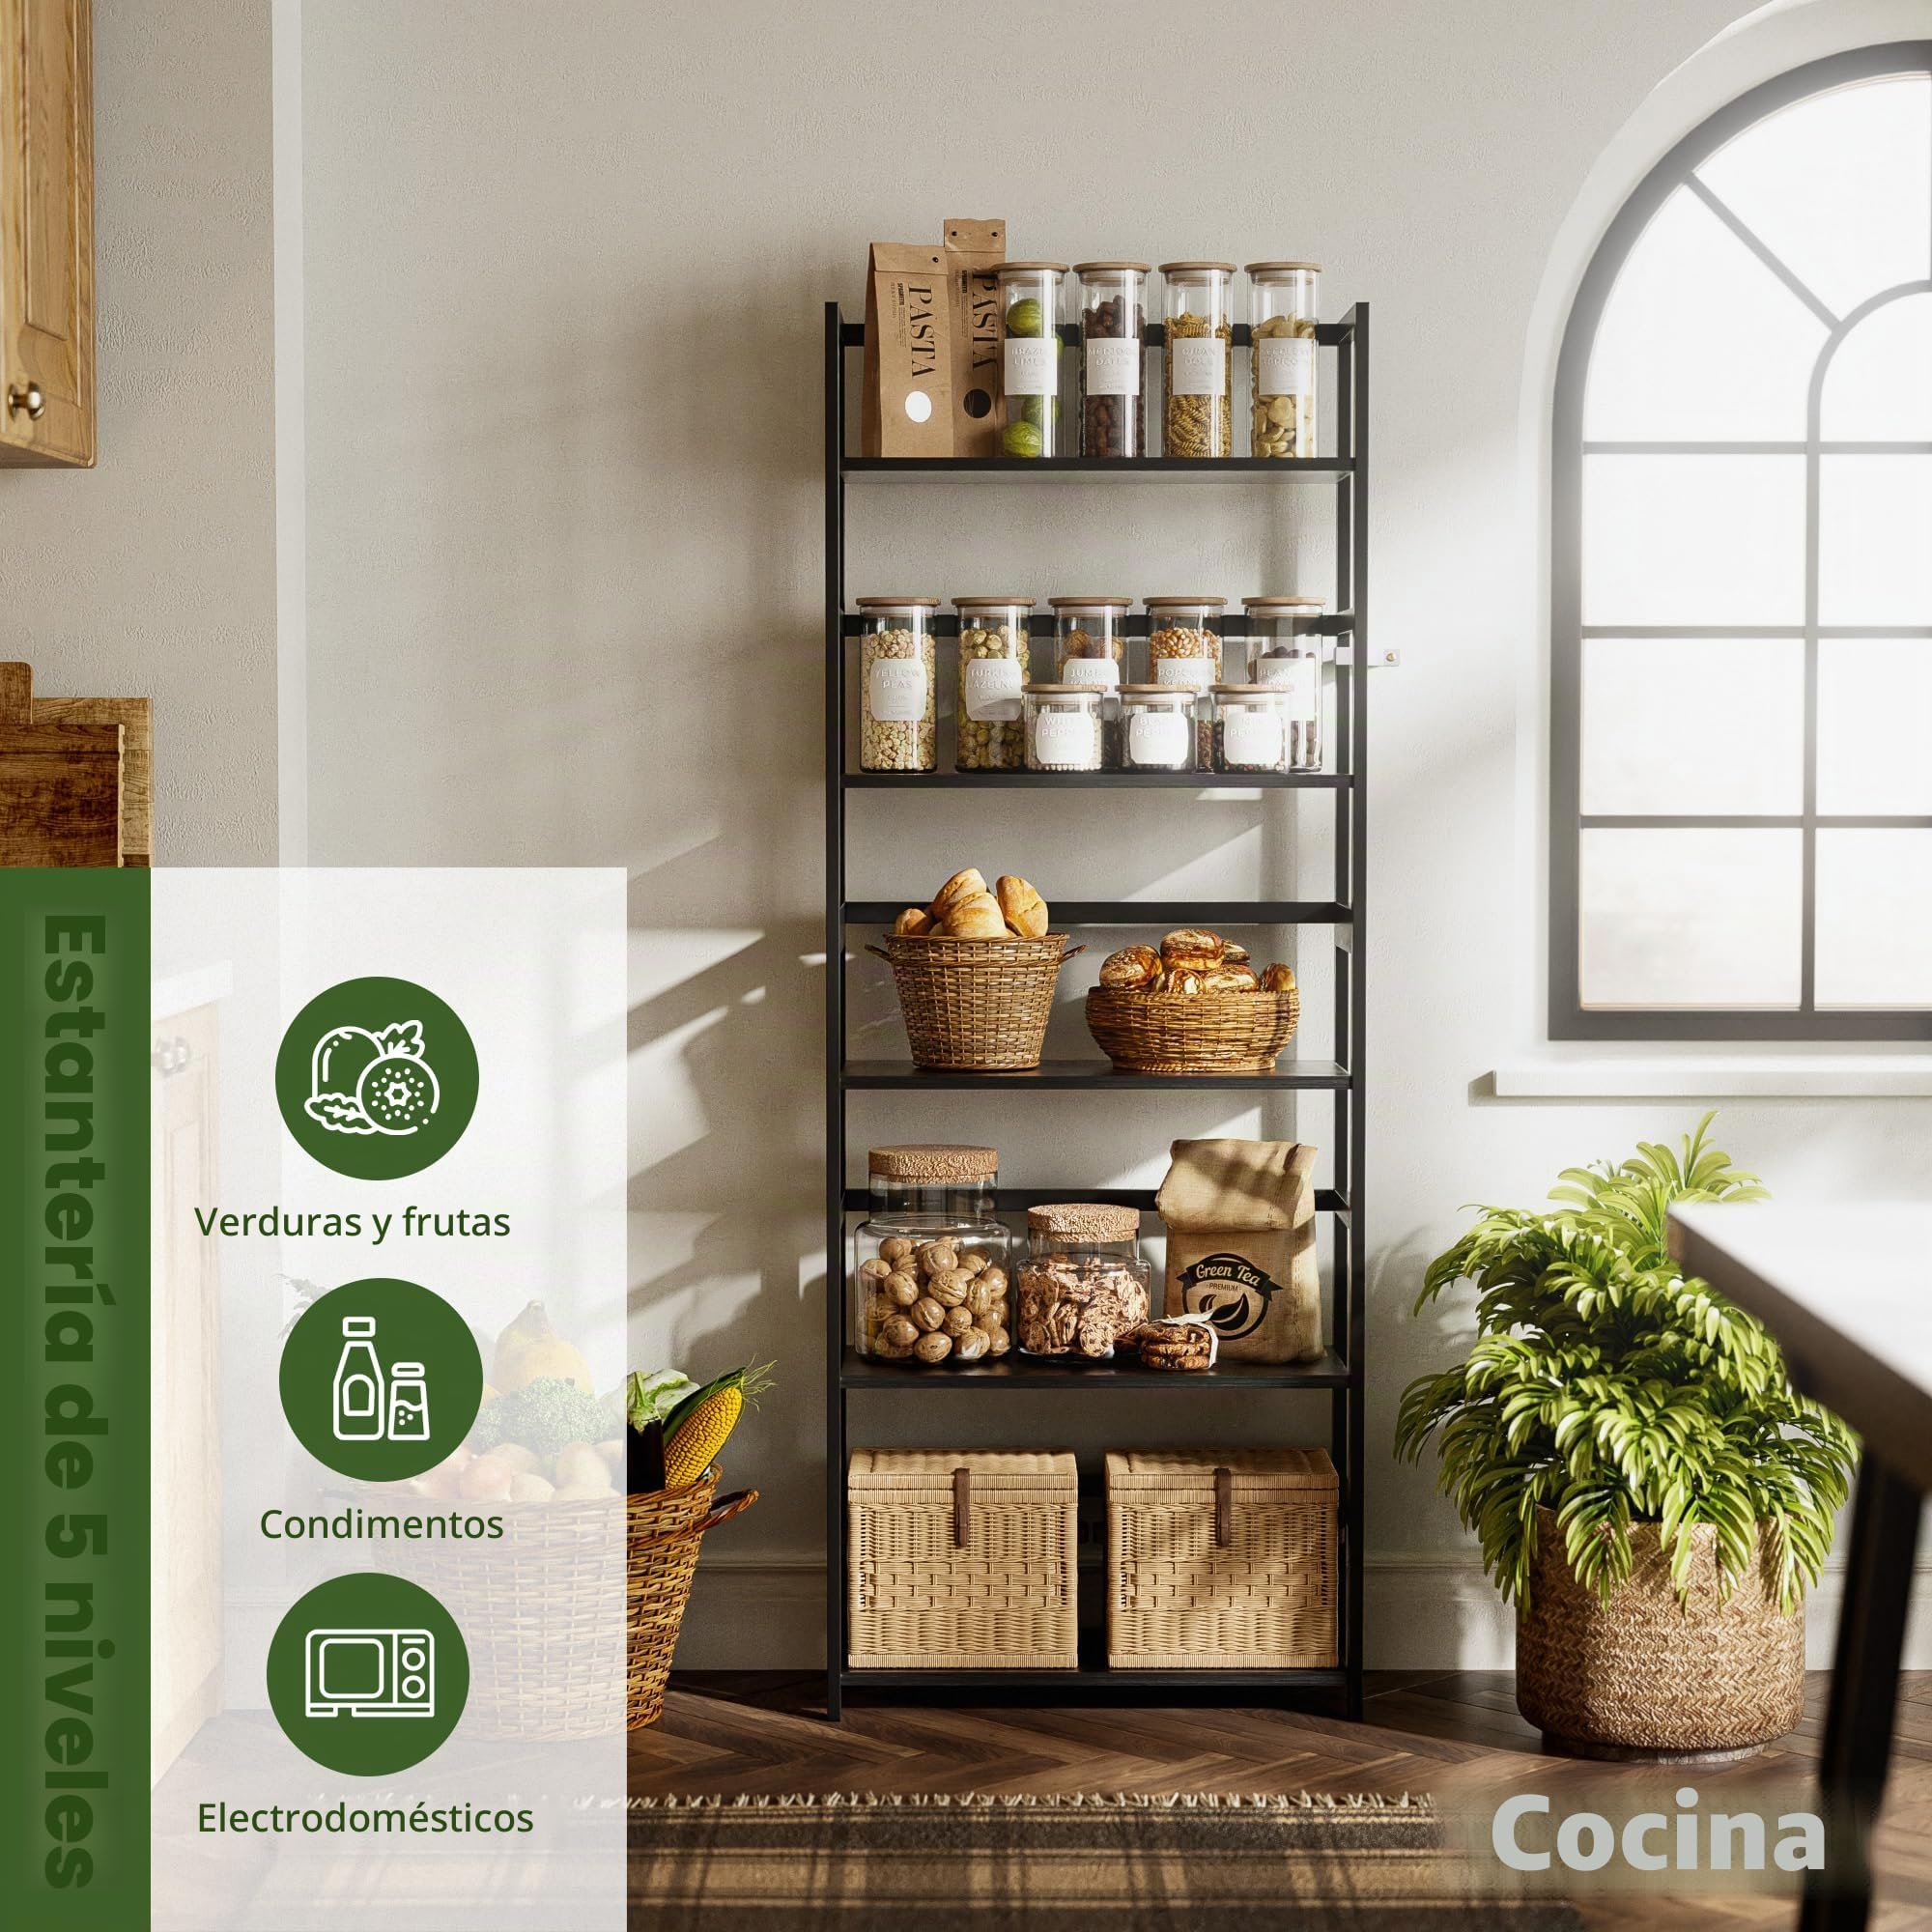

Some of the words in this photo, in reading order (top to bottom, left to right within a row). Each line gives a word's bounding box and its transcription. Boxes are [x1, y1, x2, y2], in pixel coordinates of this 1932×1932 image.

[908, 282, 936, 379] PASTA
[972, 270, 999, 371] PASTA
[882, 679, 913, 689] PEAS
[1196, 1264, 1233, 1278] Green
[1237, 1264, 1261, 1286] Tea
[1209, 1283, 1238, 1293] PREMIUM
